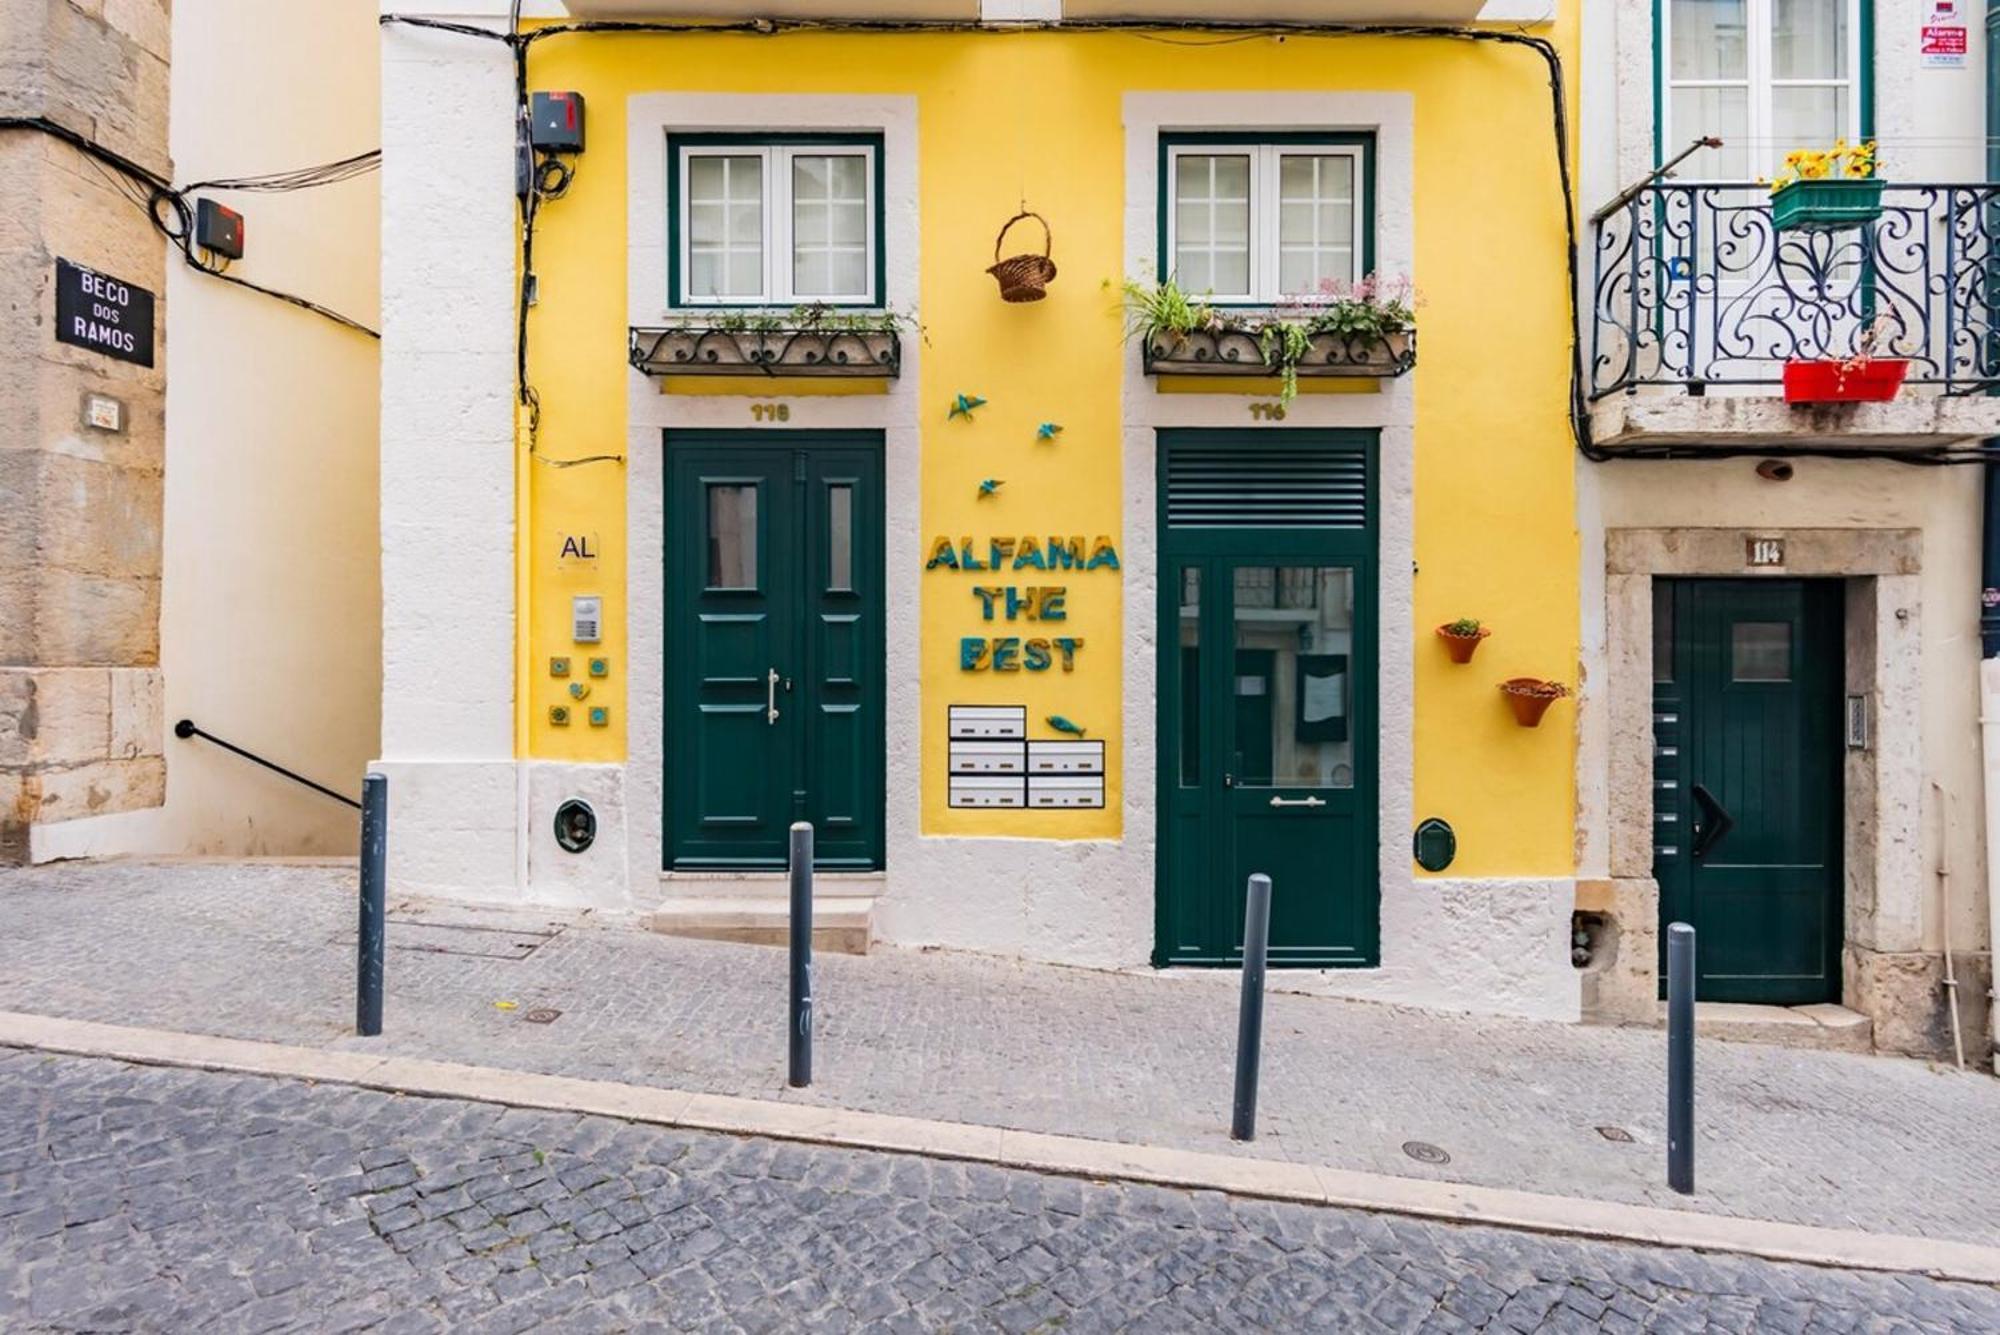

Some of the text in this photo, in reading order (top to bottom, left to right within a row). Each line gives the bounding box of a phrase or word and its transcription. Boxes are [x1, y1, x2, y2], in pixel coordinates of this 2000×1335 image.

[81, 272, 129, 306] BECO
[93, 303, 120, 323] DOS
[74, 316, 134, 352] RAMOS
[1248, 402, 1286, 421] 116
[561, 536, 595, 558] AL
[926, 535, 1120, 571] ALFAMA
[1754, 541, 1780, 563] 114
[973, 586, 1067, 621] THE
[960, 637, 1083, 673] BEST
